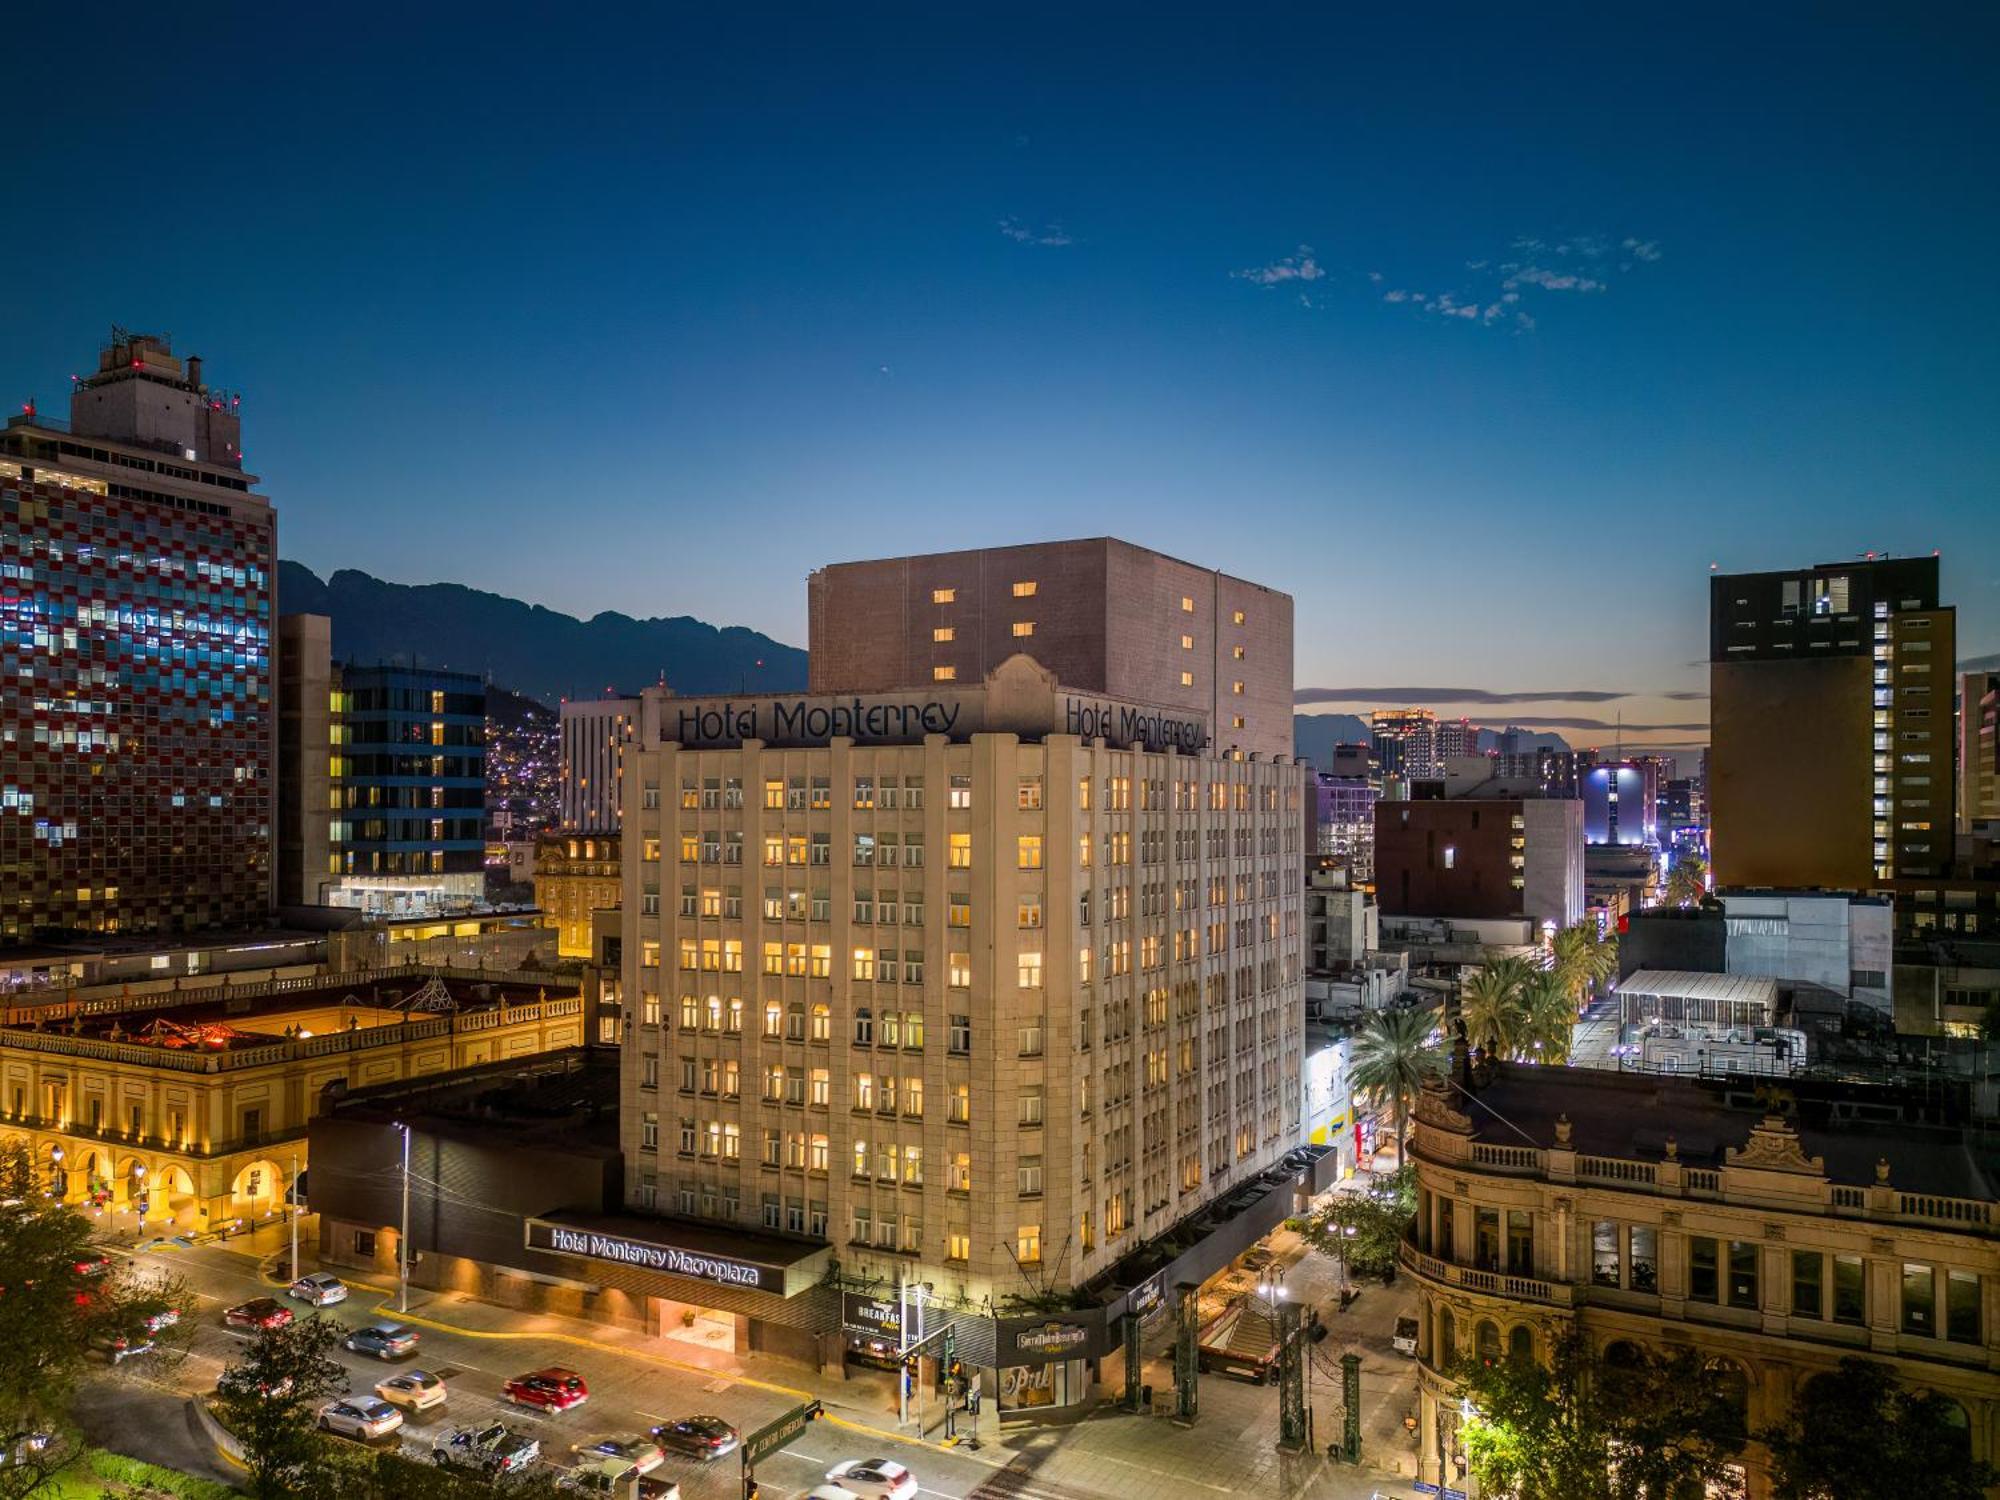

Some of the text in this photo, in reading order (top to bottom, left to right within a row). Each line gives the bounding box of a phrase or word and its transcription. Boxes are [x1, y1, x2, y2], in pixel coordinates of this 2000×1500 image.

[679, 698, 960, 741] Hotel Monterrey
[1067, 697, 1200, 748] Hotel Monterrey
[551, 1229, 759, 1286] Hotel Monterrey Macroplaza
[858, 1306, 901, 1325] BREAKFAS
